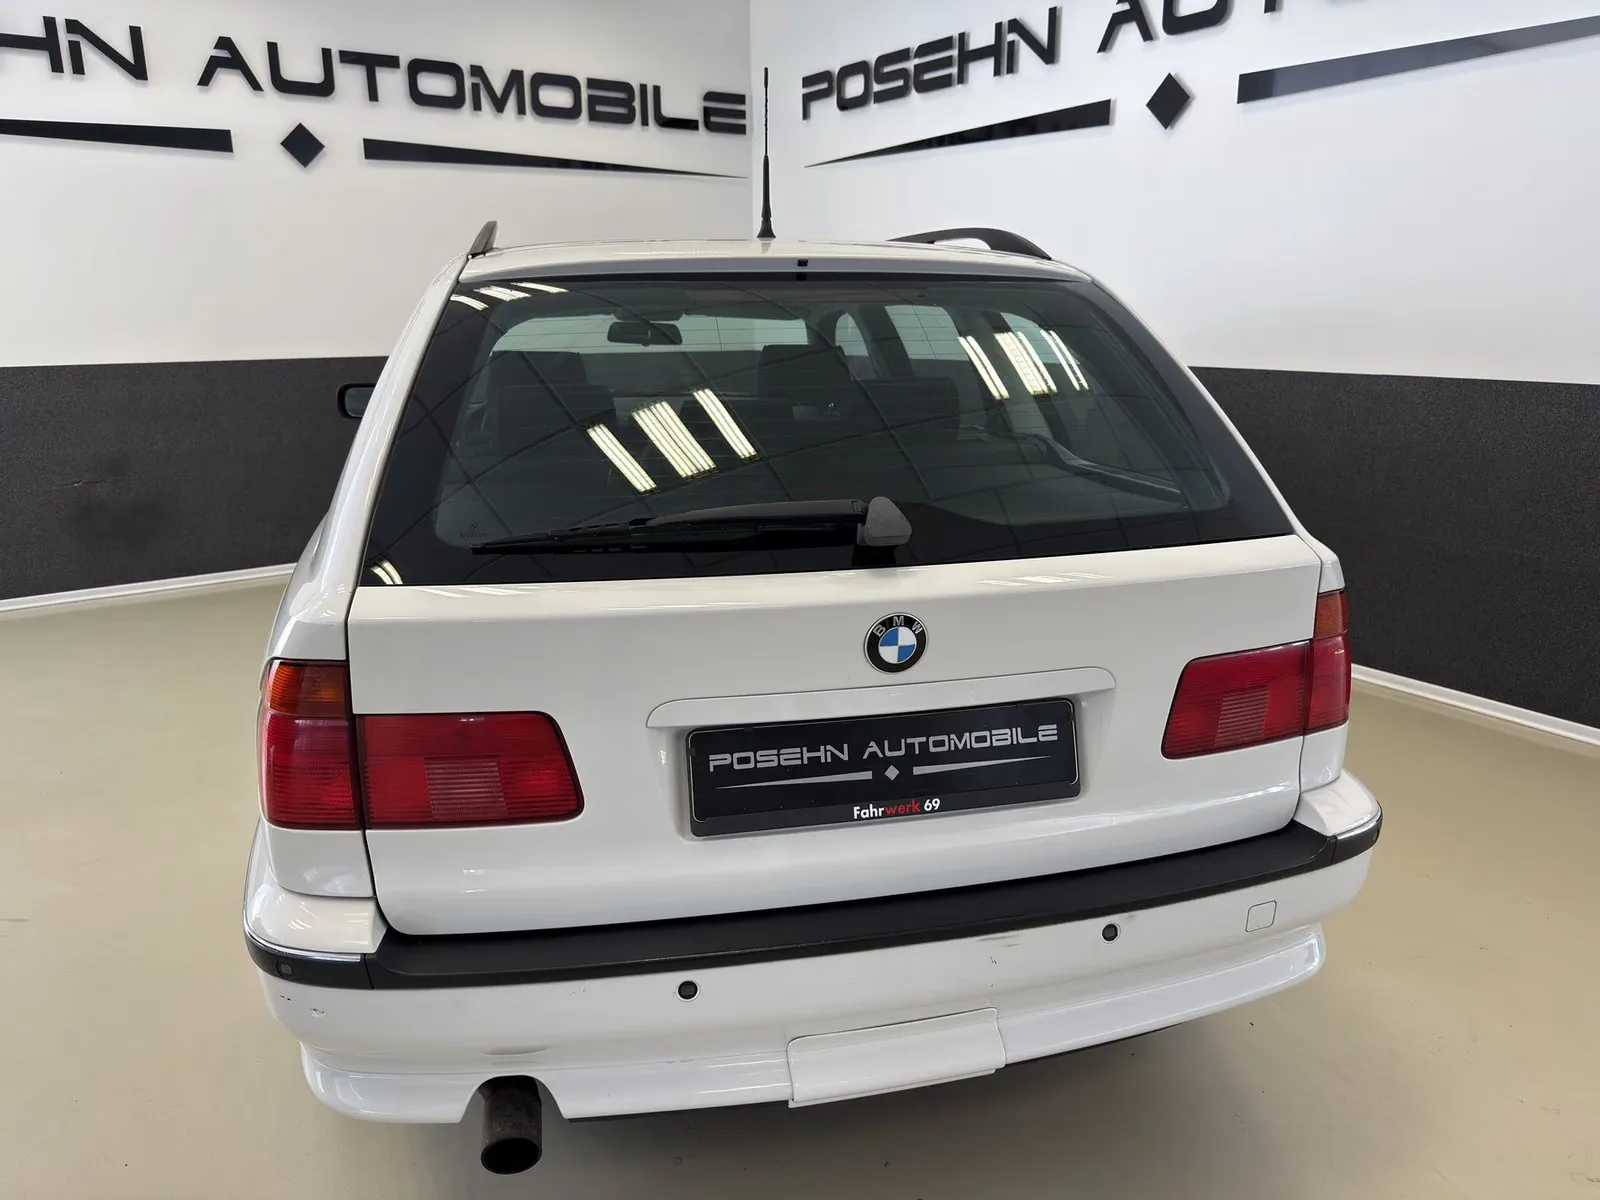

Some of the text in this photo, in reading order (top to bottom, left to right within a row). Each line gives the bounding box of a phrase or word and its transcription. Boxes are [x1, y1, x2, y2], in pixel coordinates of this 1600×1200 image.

[197, 36, 747, 135] AUTOMOBILE
[802, 7, 1059, 120] POSEHN
[872, 615, 923, 637] BMW
[709, 723, 1058, 772] POSEHN AUTOMOBILE
[853, 798, 940, 819] Fahrwerk 69
